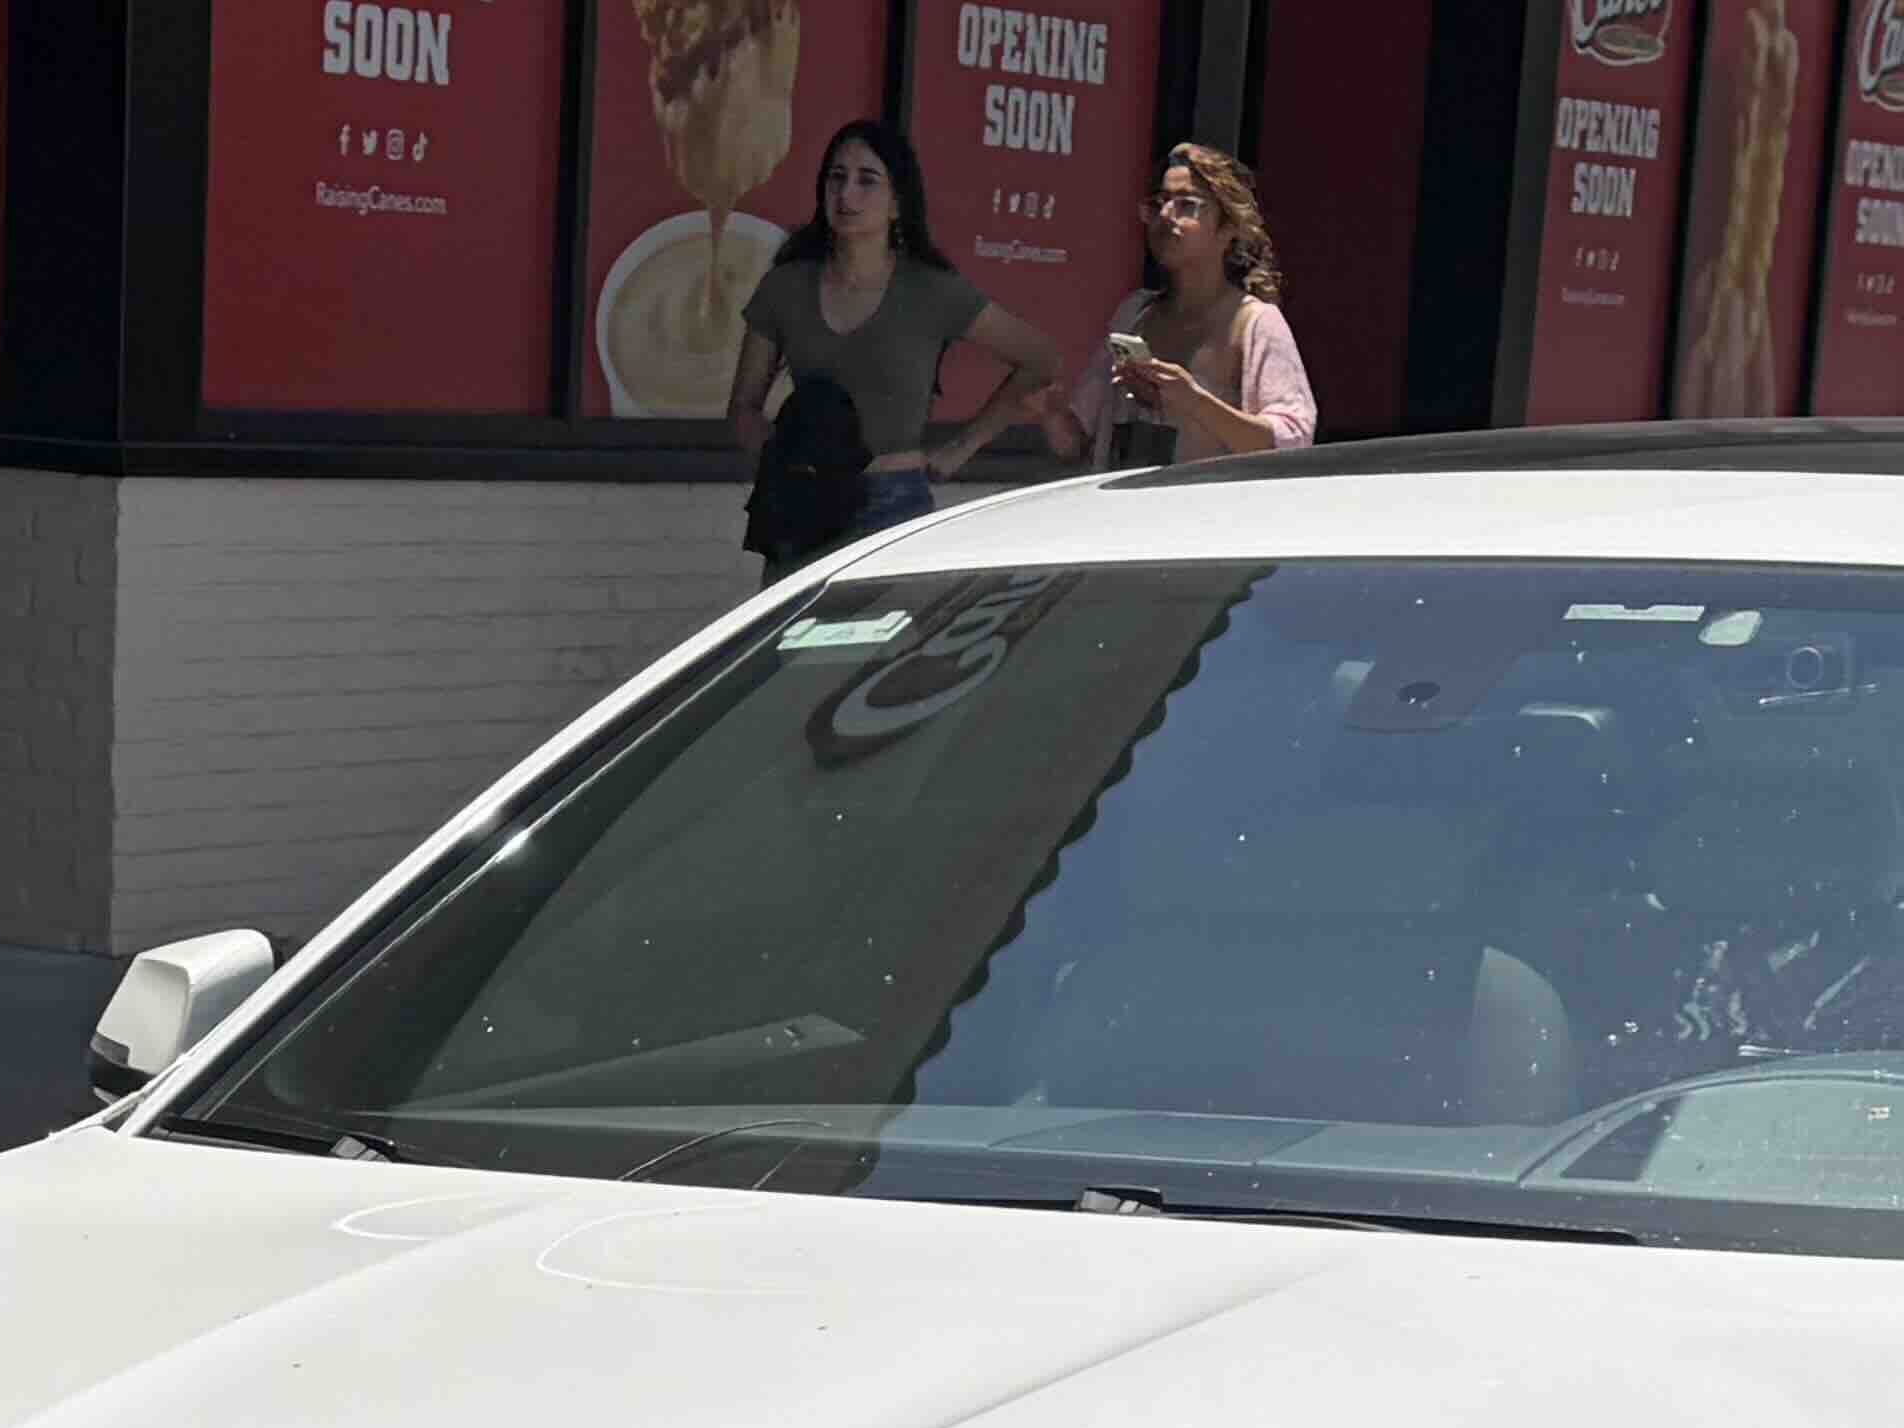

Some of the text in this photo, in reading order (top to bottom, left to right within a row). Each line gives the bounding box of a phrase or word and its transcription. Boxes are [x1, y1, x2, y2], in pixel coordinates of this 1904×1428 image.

[322, 0, 452, 86] SOON
[957, 3, 1108, 85] OPENING
[982, 83, 1076, 156] SOON
[1553, 96, 1661, 160] OPENING
[1569, 161, 1637, 219] SOON
